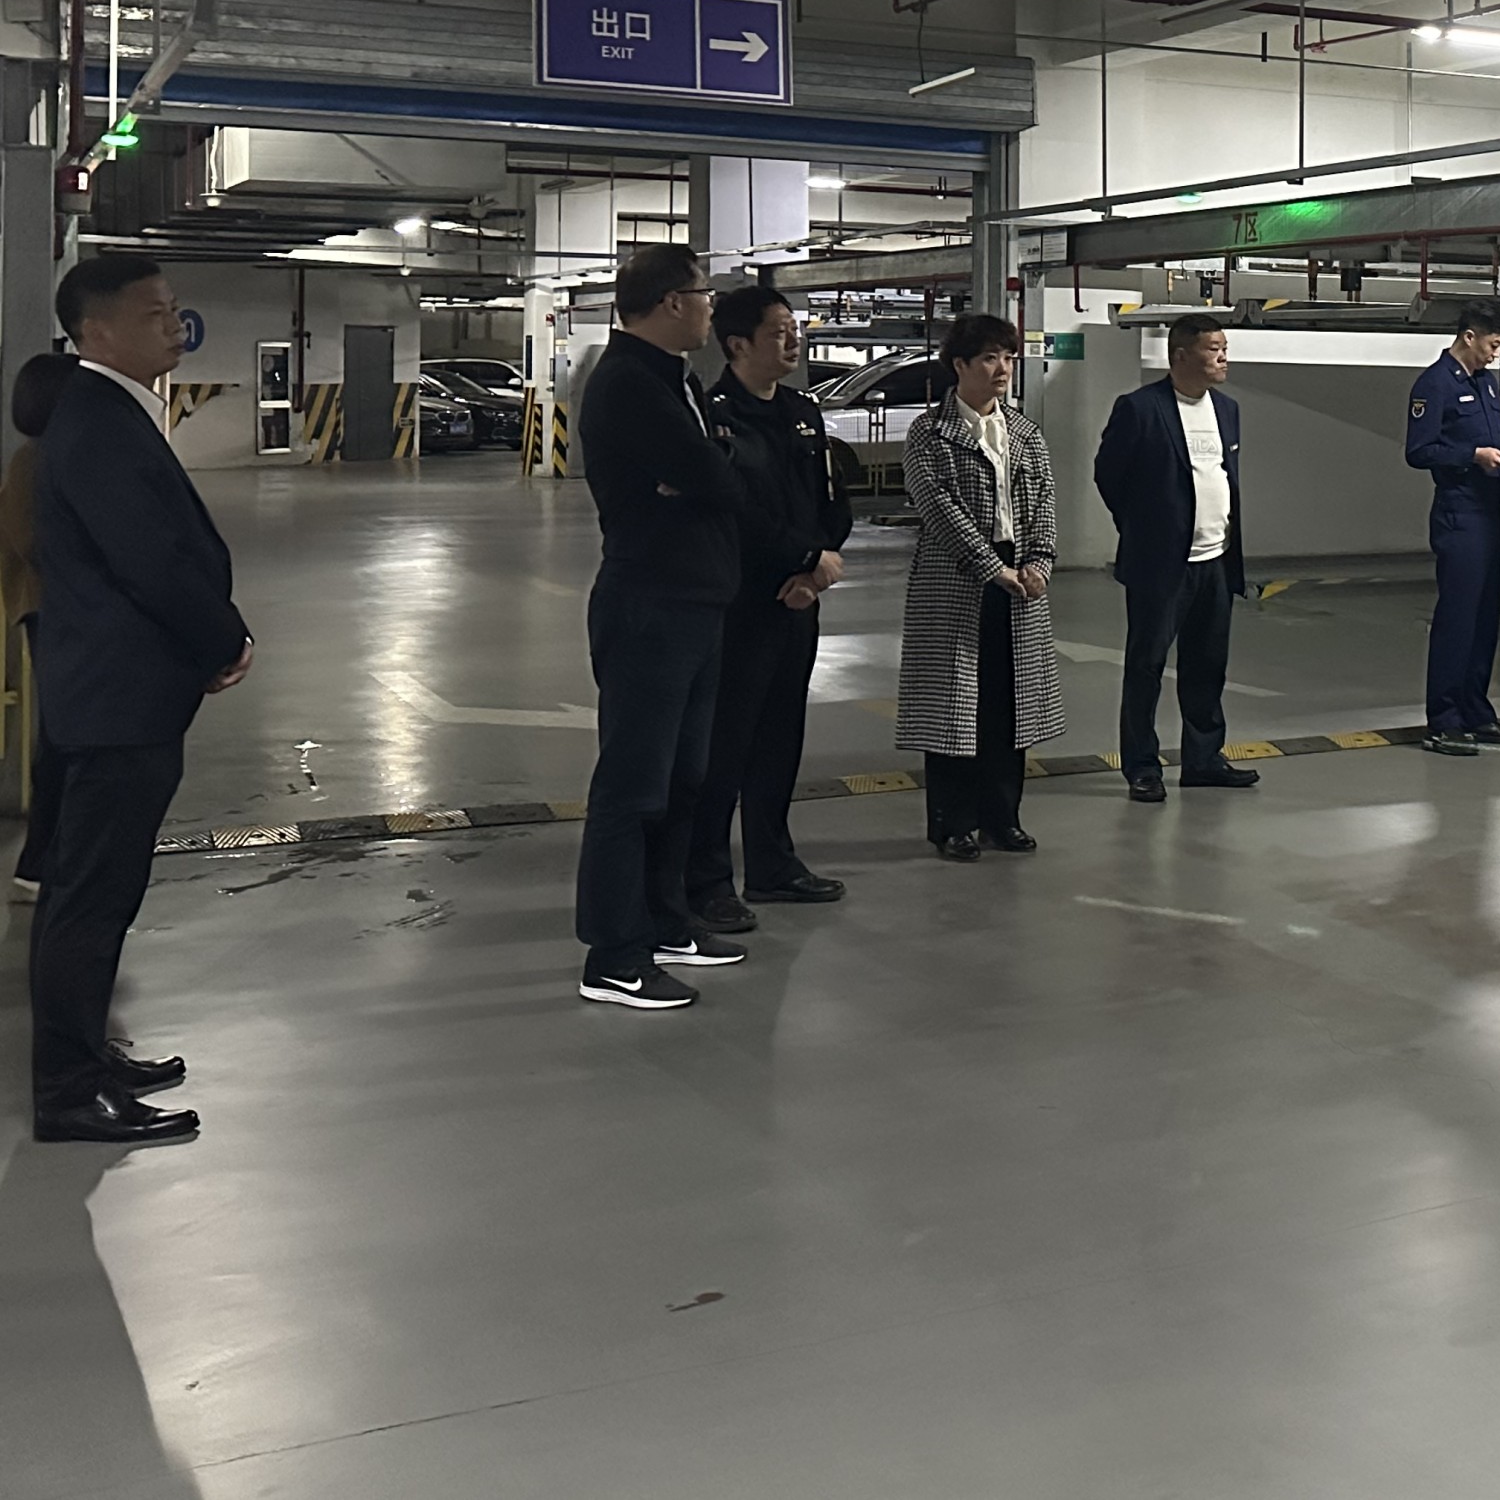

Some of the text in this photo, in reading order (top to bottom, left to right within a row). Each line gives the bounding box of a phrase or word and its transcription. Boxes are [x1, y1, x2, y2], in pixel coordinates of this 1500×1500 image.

[591, 7, 651, 41] 出口
[601, 46, 634, 60] EXIT
[1232, 211, 1258, 244] 7区
